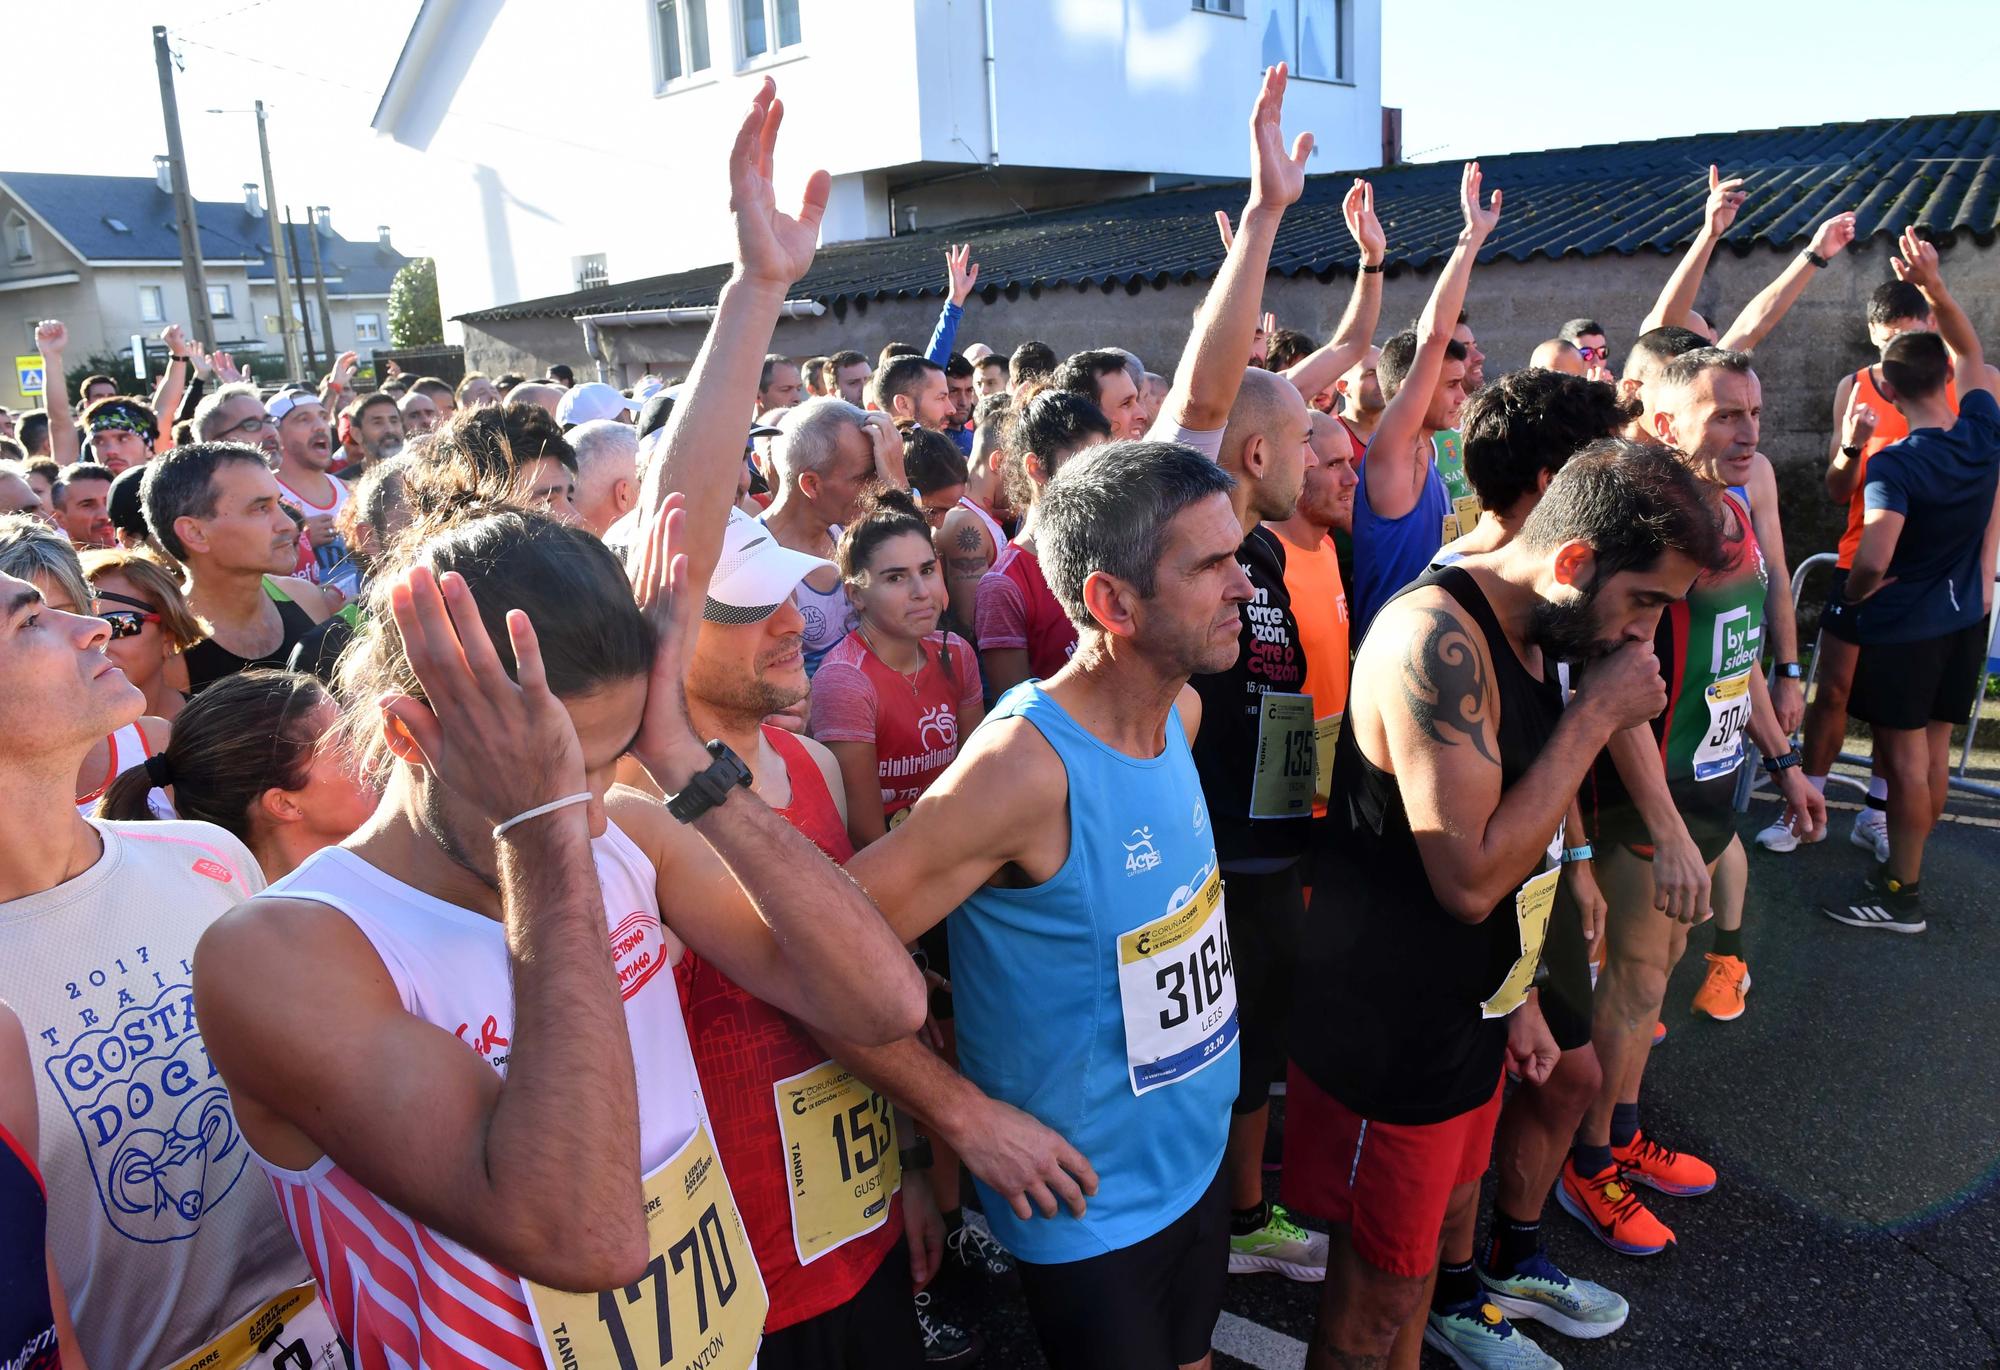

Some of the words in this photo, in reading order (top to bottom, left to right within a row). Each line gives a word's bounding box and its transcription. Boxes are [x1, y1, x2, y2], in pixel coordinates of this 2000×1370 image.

[1727, 628, 1745, 651] by
[65, 946, 149, 1000] 2017
[1156, 920, 1232, 1029] 3164
[40, 959, 194, 1047] TRAIL
[1202, 1006, 1223, 1031] LEIS
[1203, 1034, 1224, 1056] 23.10
[688, 1157, 703, 1178] XENTE
[792, 1142, 804, 1188] TANDA
[797, 1189, 805, 1197] 1
[598, 1203, 738, 1370] 1770
[249, 1325, 255, 1335] A
[256, 1304, 279, 1326] XENTE
[250, 1324, 266, 1341] DOS
[266, 1295, 300, 1325] BARRIOS
